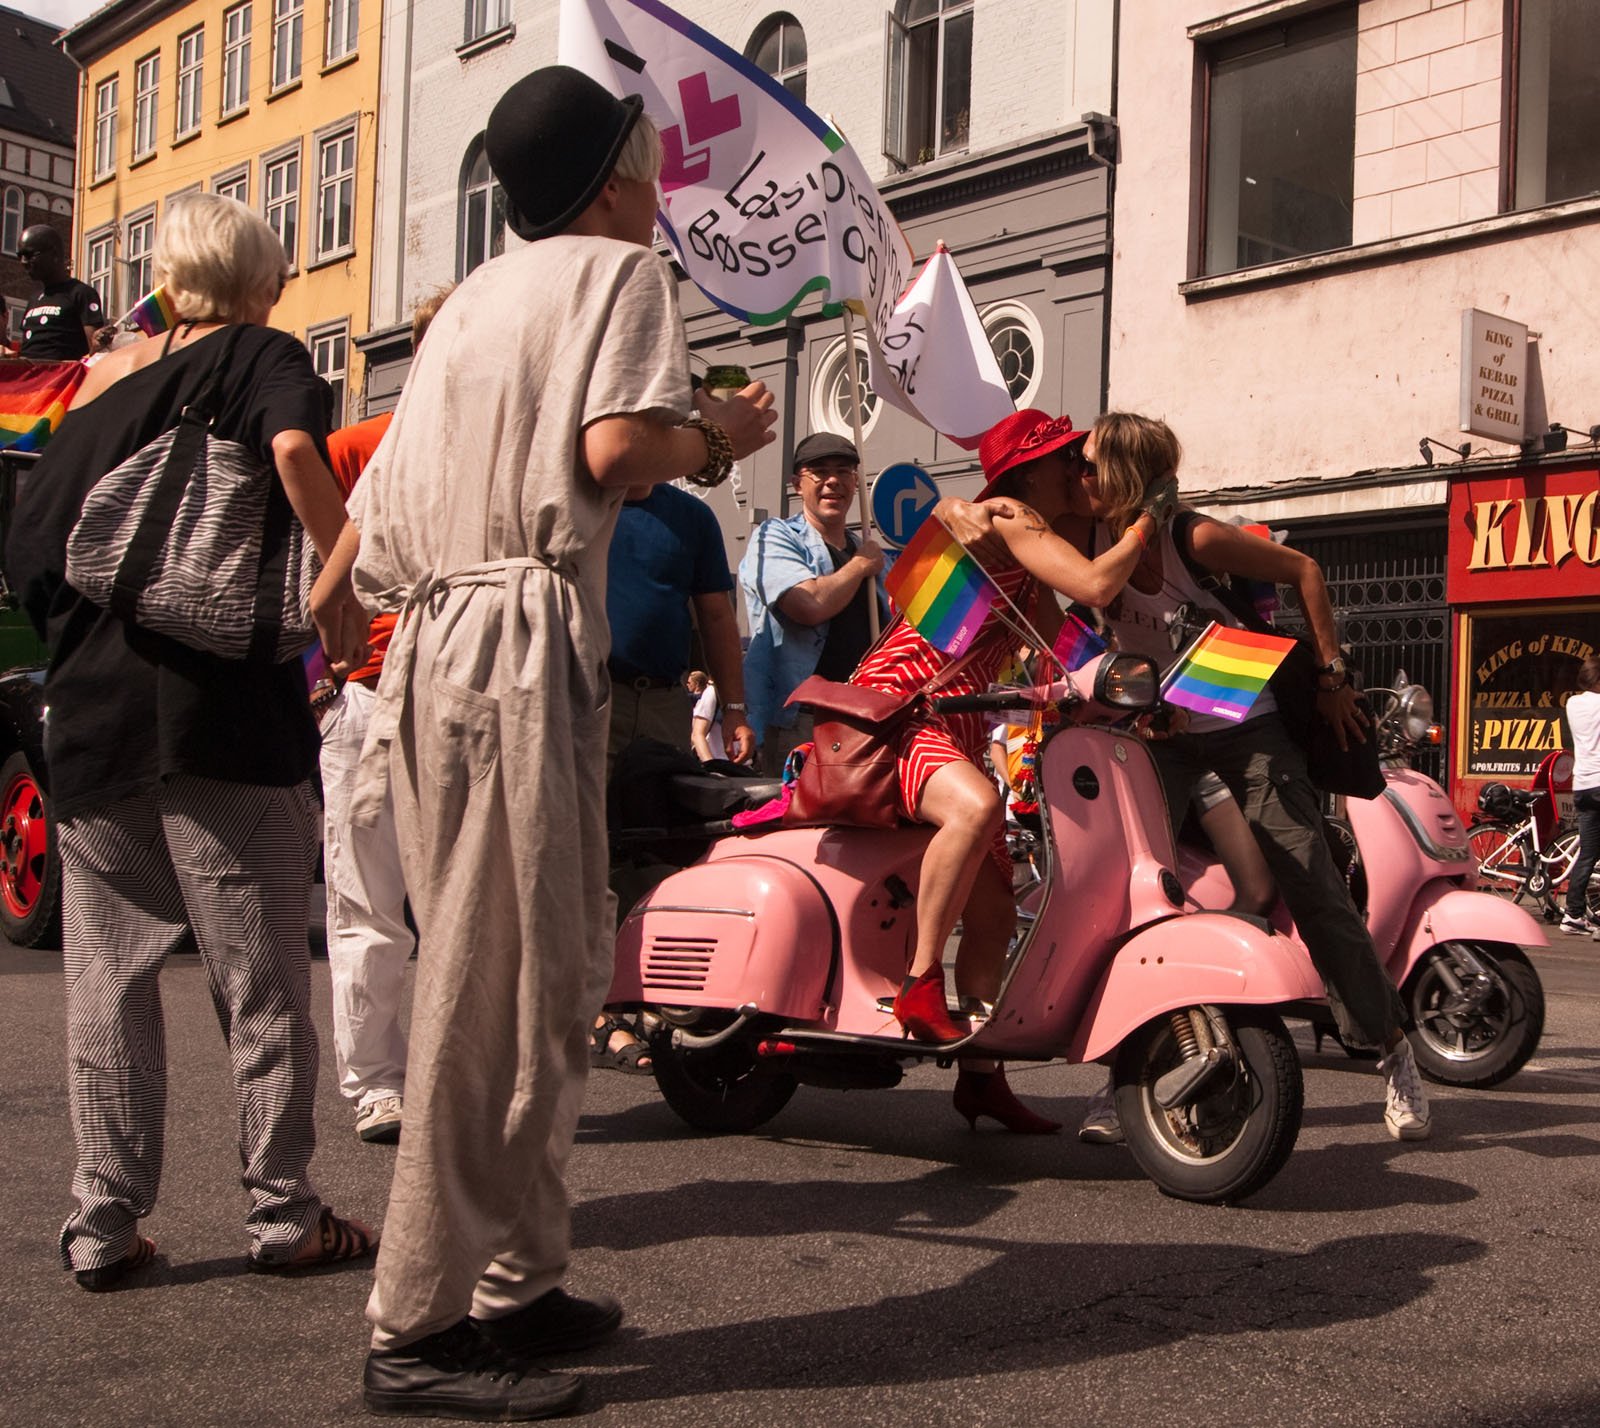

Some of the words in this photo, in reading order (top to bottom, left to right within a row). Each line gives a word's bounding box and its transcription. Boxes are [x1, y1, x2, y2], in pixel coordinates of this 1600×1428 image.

[688, 208, 828, 277] Bøsse
[1485, 330, 1513, 348] KING
[1493, 354, 1505, 367] of
[1479, 367, 1517, 387] KEBAB
[1481, 386, 1514, 406] PIZZA
[1474, 404, 1483, 416] &
[1486, 407, 1520, 426] GRILL
[1466, 490, 1600, 569] KING
[1476, 640, 1522, 684] KING
[1528, 634, 1549, 656] of
[1550, 635, 1594, 661] KEB
[1474, 691, 1531, 708] PIZZA
[1537, 691, 1553, 708] &
[1480, 718, 1563, 751] PIZZA
